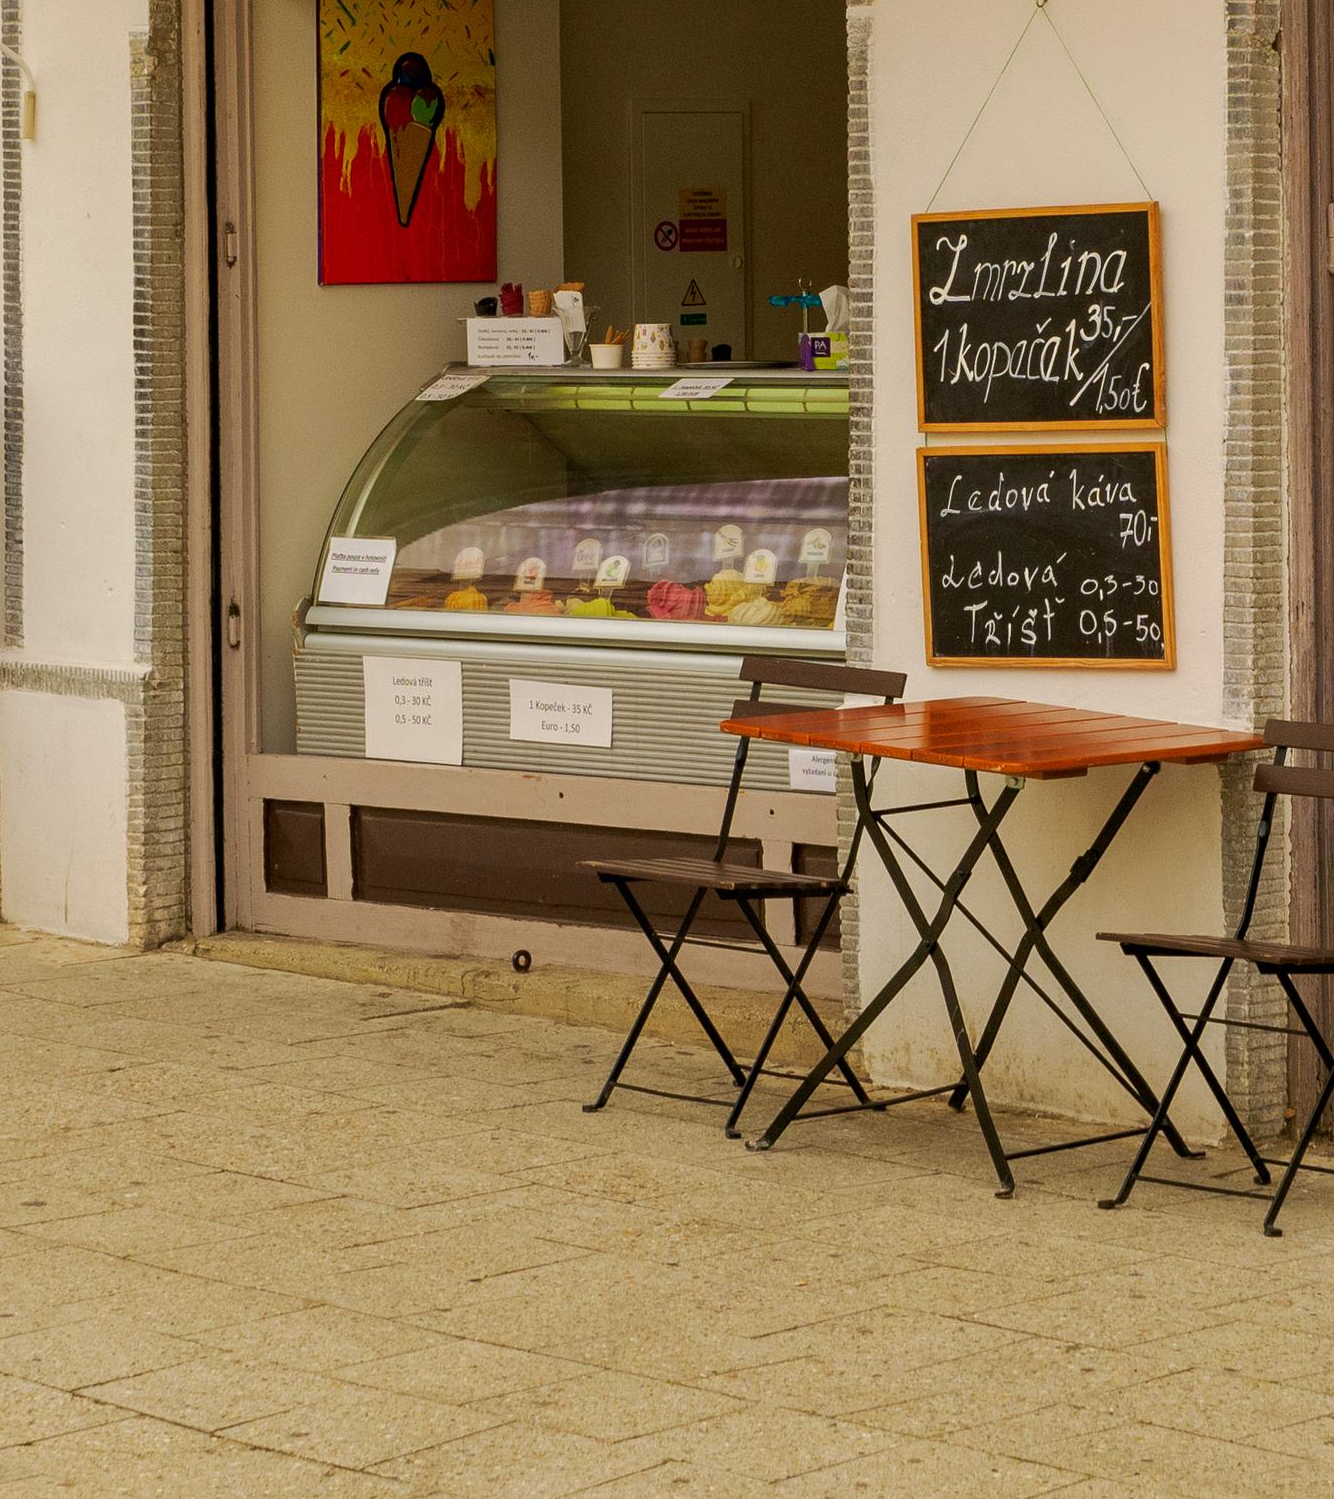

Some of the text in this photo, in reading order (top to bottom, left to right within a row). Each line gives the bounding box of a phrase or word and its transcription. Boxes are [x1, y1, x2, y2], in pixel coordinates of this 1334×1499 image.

[929, 232, 1128, 305] Zmrzlina
[1069, 469, 1138, 511] káva
[392, 676, 418, 687] Ledová
[394, 695, 406, 706] 0,3
[411, 696, 421, 706] 30
[536, 700, 566, 712] Kopeček
[572, 703, 581, 714] 35
[395, 714, 407, 725] 0,5
[411, 715, 421, 725] 50
[541, 720, 559, 732] Euro
[565, 723, 581, 734] 1,50
